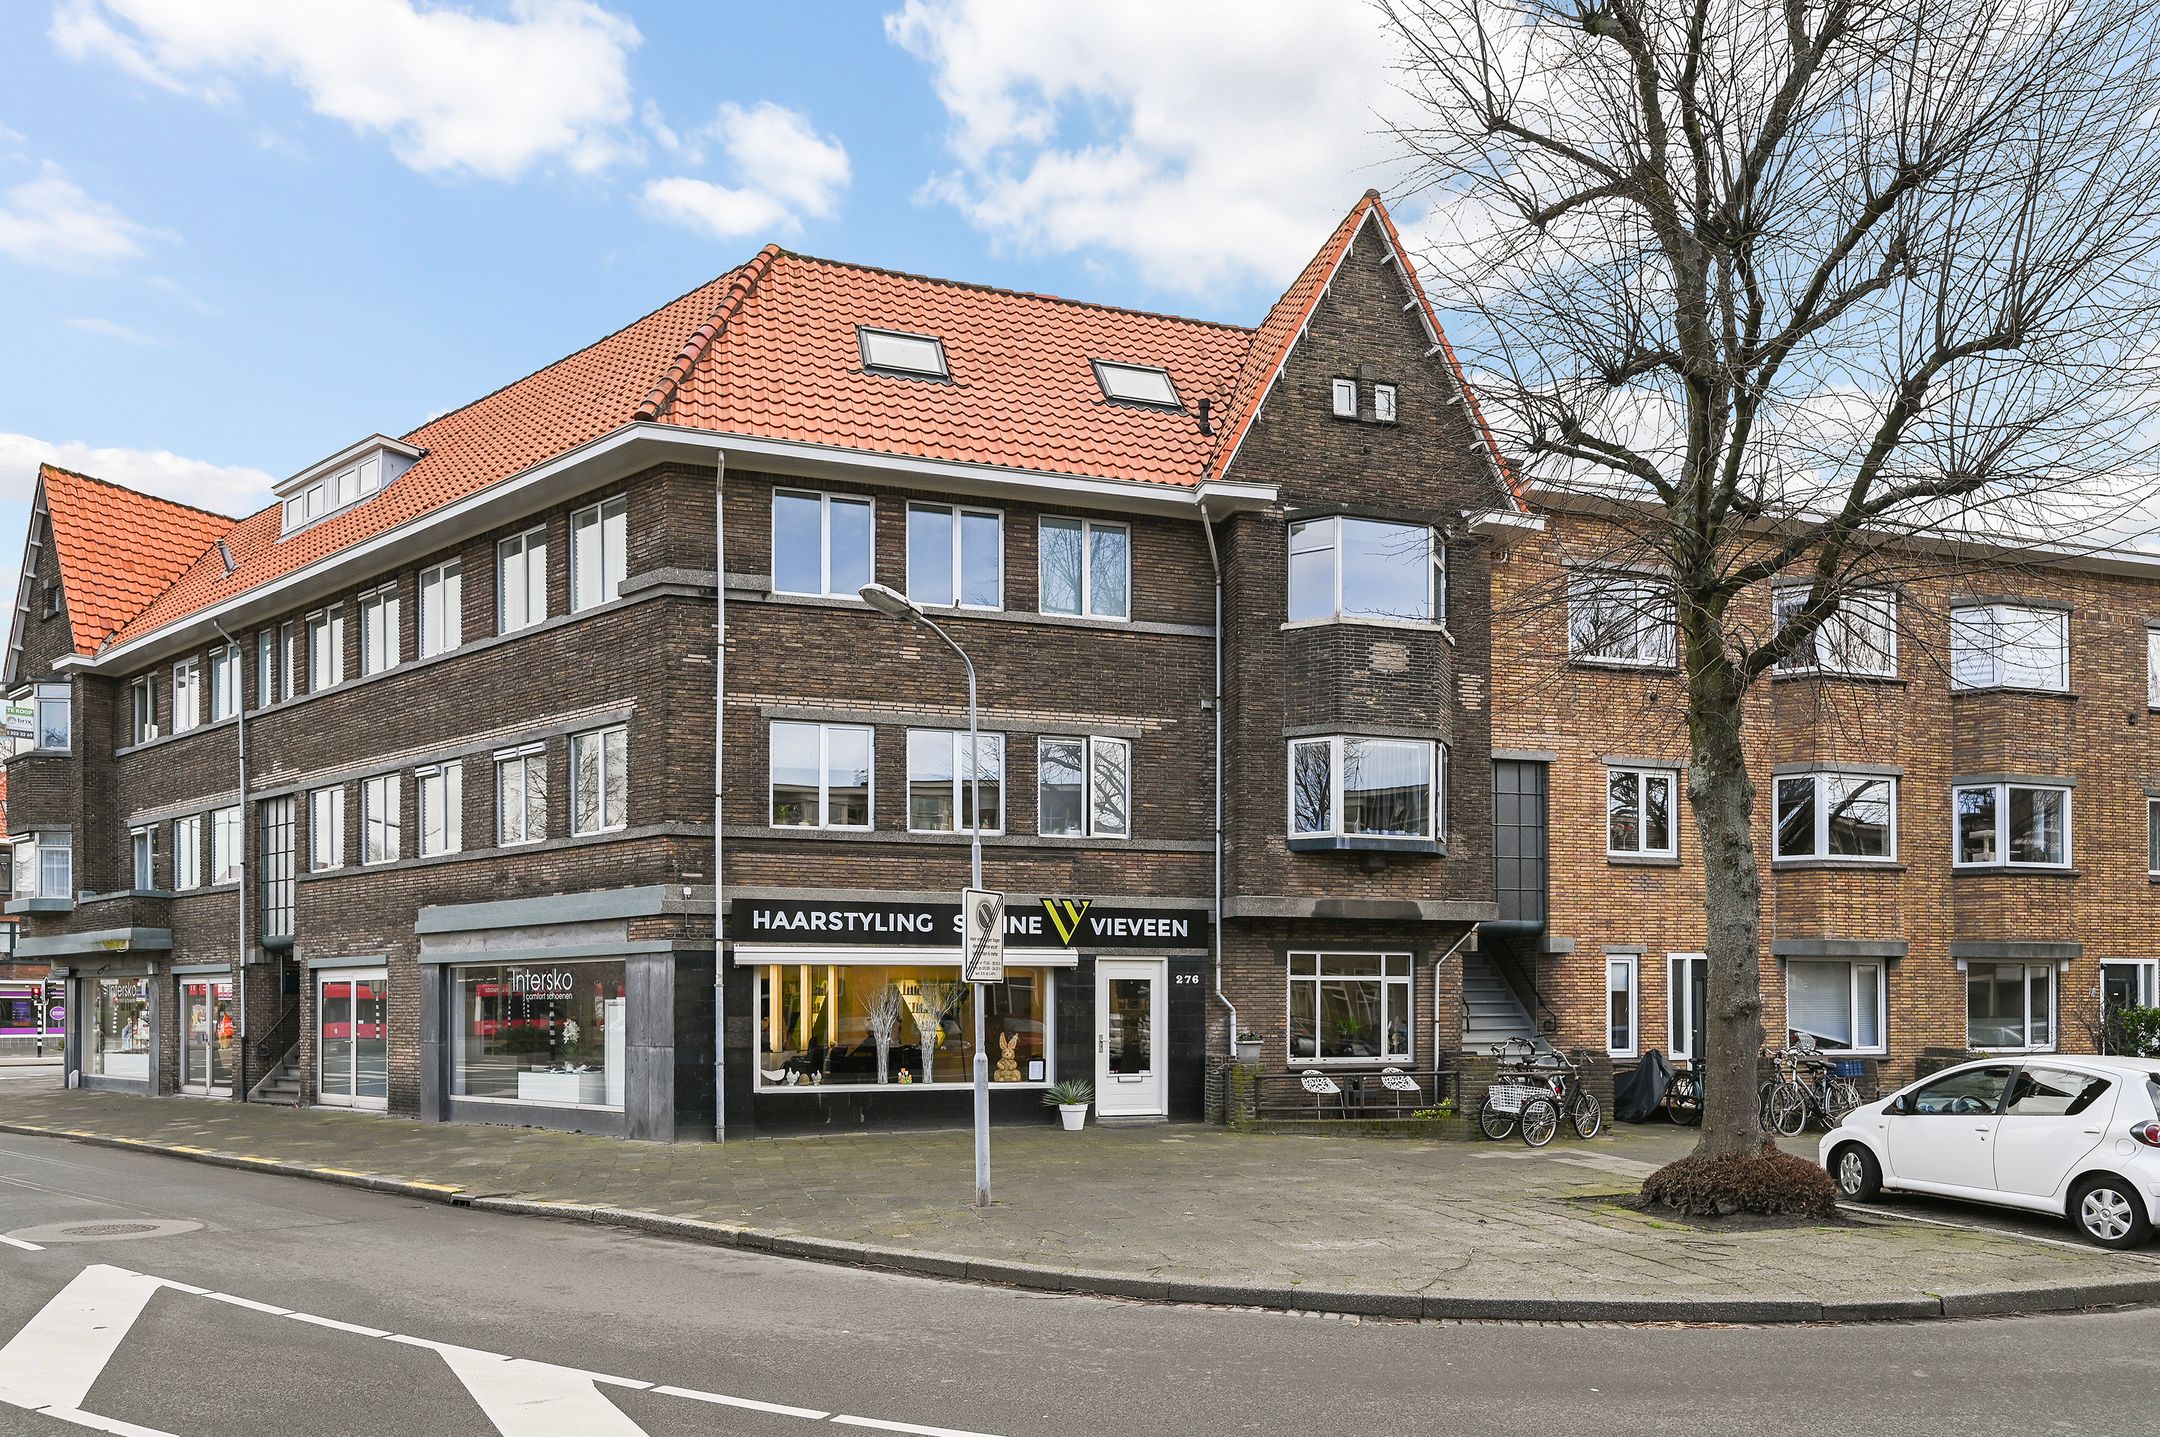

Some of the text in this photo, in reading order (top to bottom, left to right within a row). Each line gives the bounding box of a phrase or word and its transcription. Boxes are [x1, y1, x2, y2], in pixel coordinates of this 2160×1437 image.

[753, 909, 934, 933] HAARSTYLING
[952, 914, 1042, 935] SINE
[1090, 916, 1188, 938] VIEVEEN
[512, 967, 573, 992] Intersko
[1175, 974, 1200, 984] 276
[525, 992, 573, 1000] comfort schoenen
